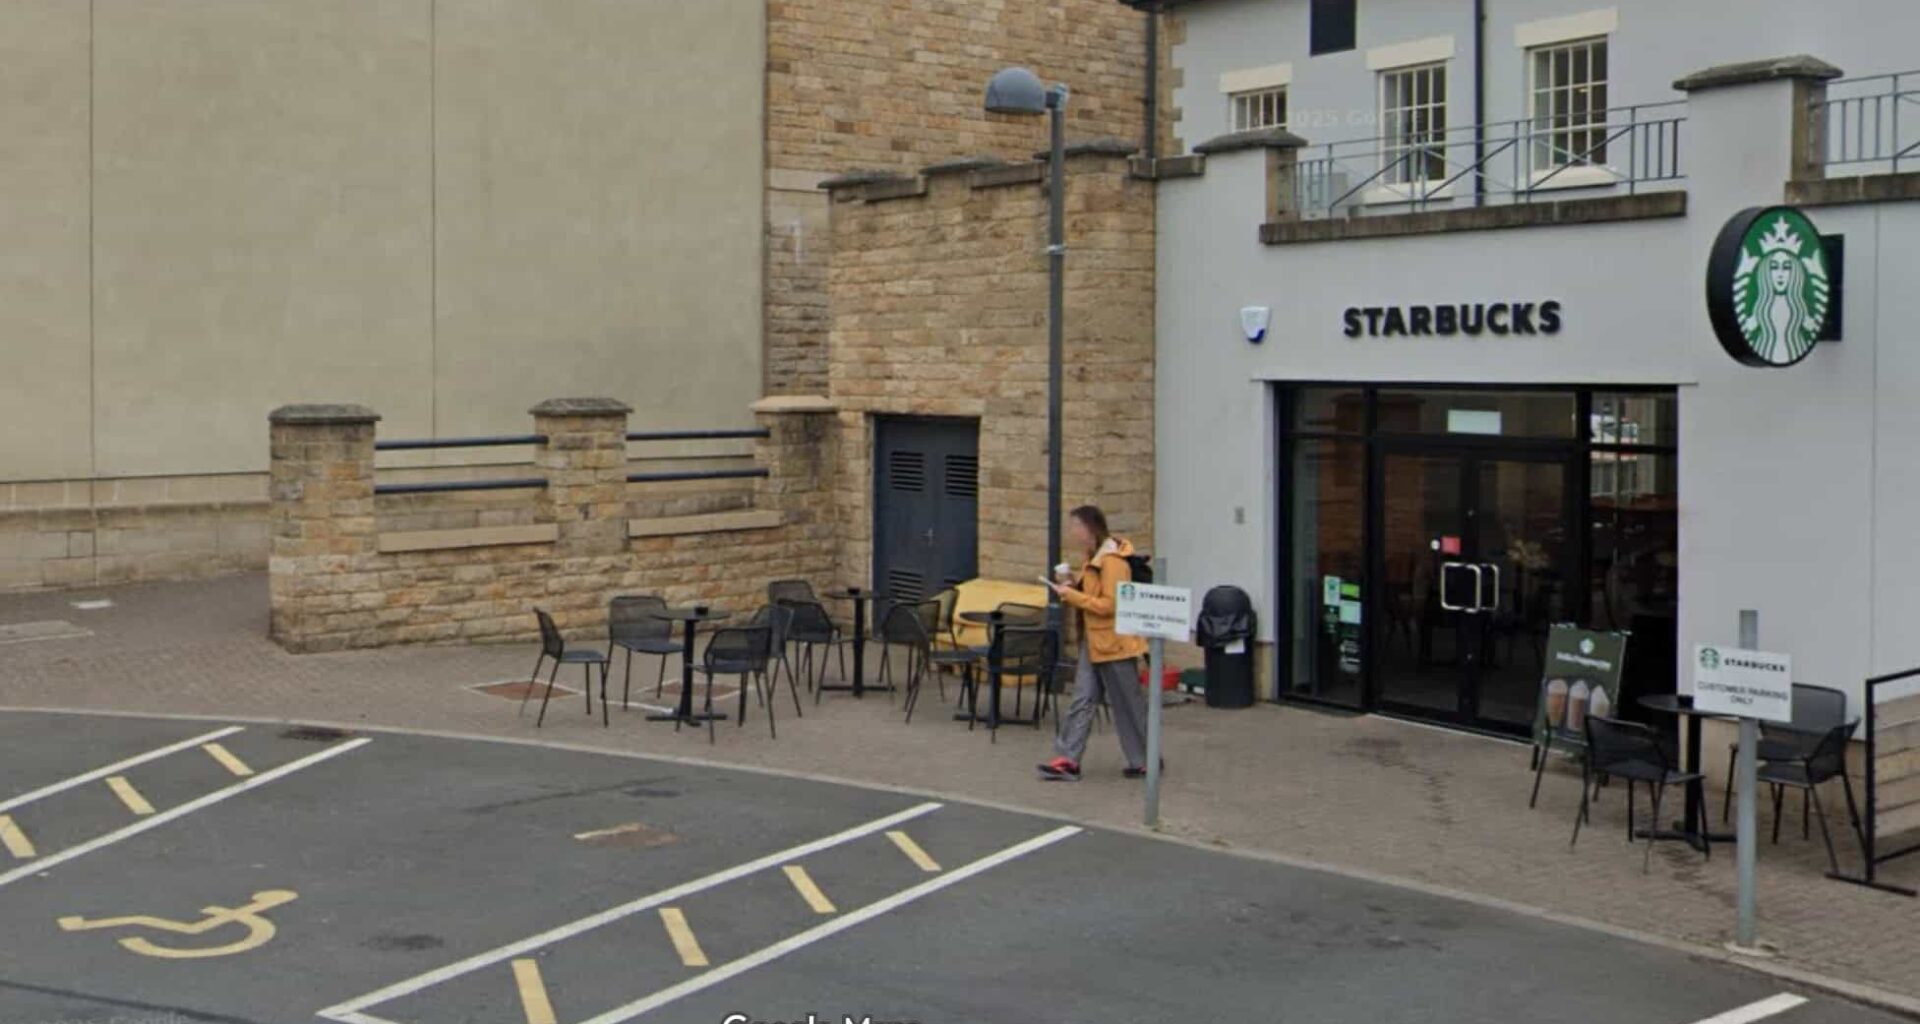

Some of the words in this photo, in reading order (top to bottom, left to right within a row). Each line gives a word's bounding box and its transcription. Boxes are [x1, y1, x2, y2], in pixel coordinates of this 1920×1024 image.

[1343, 300, 1562, 338] STARBUCKS
[1140, 592, 1186, 603] STARBUCKS
[1724, 658, 1785, 672] STARBUCKS
[1698, 681, 1746, 694] CUSTOMER
[1748, 687, 1788, 701] PARKING
[1730, 695, 1753, 704] ONLY
